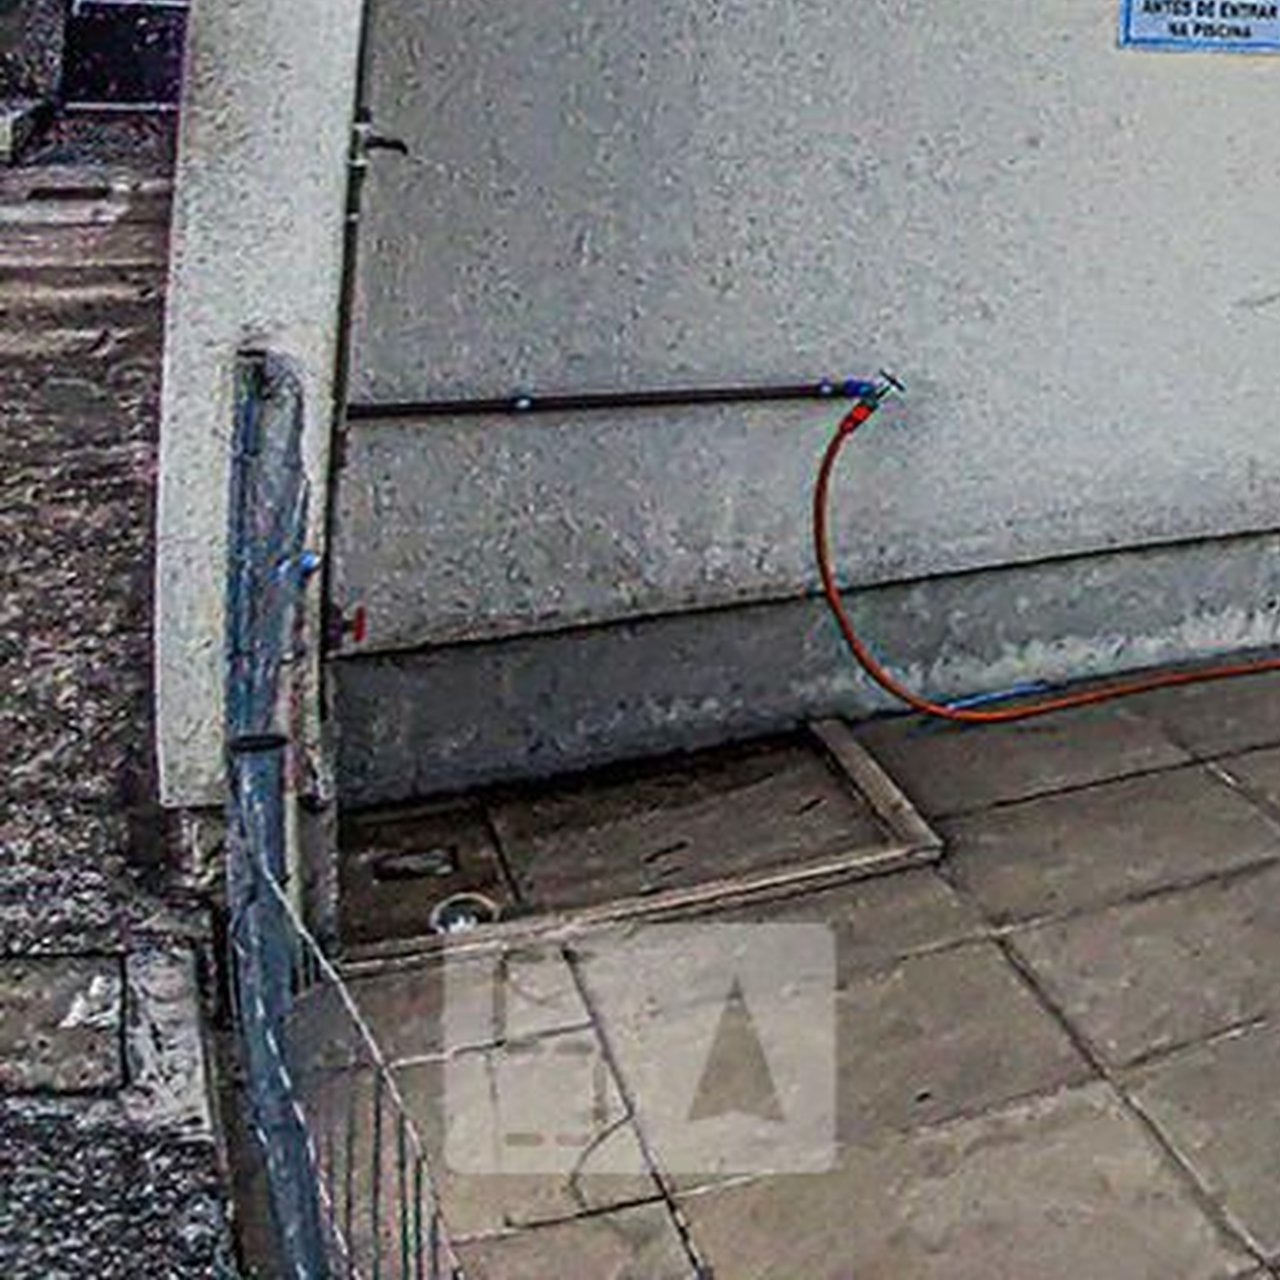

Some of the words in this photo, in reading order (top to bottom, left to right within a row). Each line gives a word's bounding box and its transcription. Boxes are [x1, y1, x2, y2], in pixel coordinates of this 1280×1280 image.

[1141, 0, 1192, 16] ANTES
[1197, 0, 1215, 18] DE
[1220, 2, 1278, 20] ENTRAR
[1193, 23, 1252, 38] PISCINA
